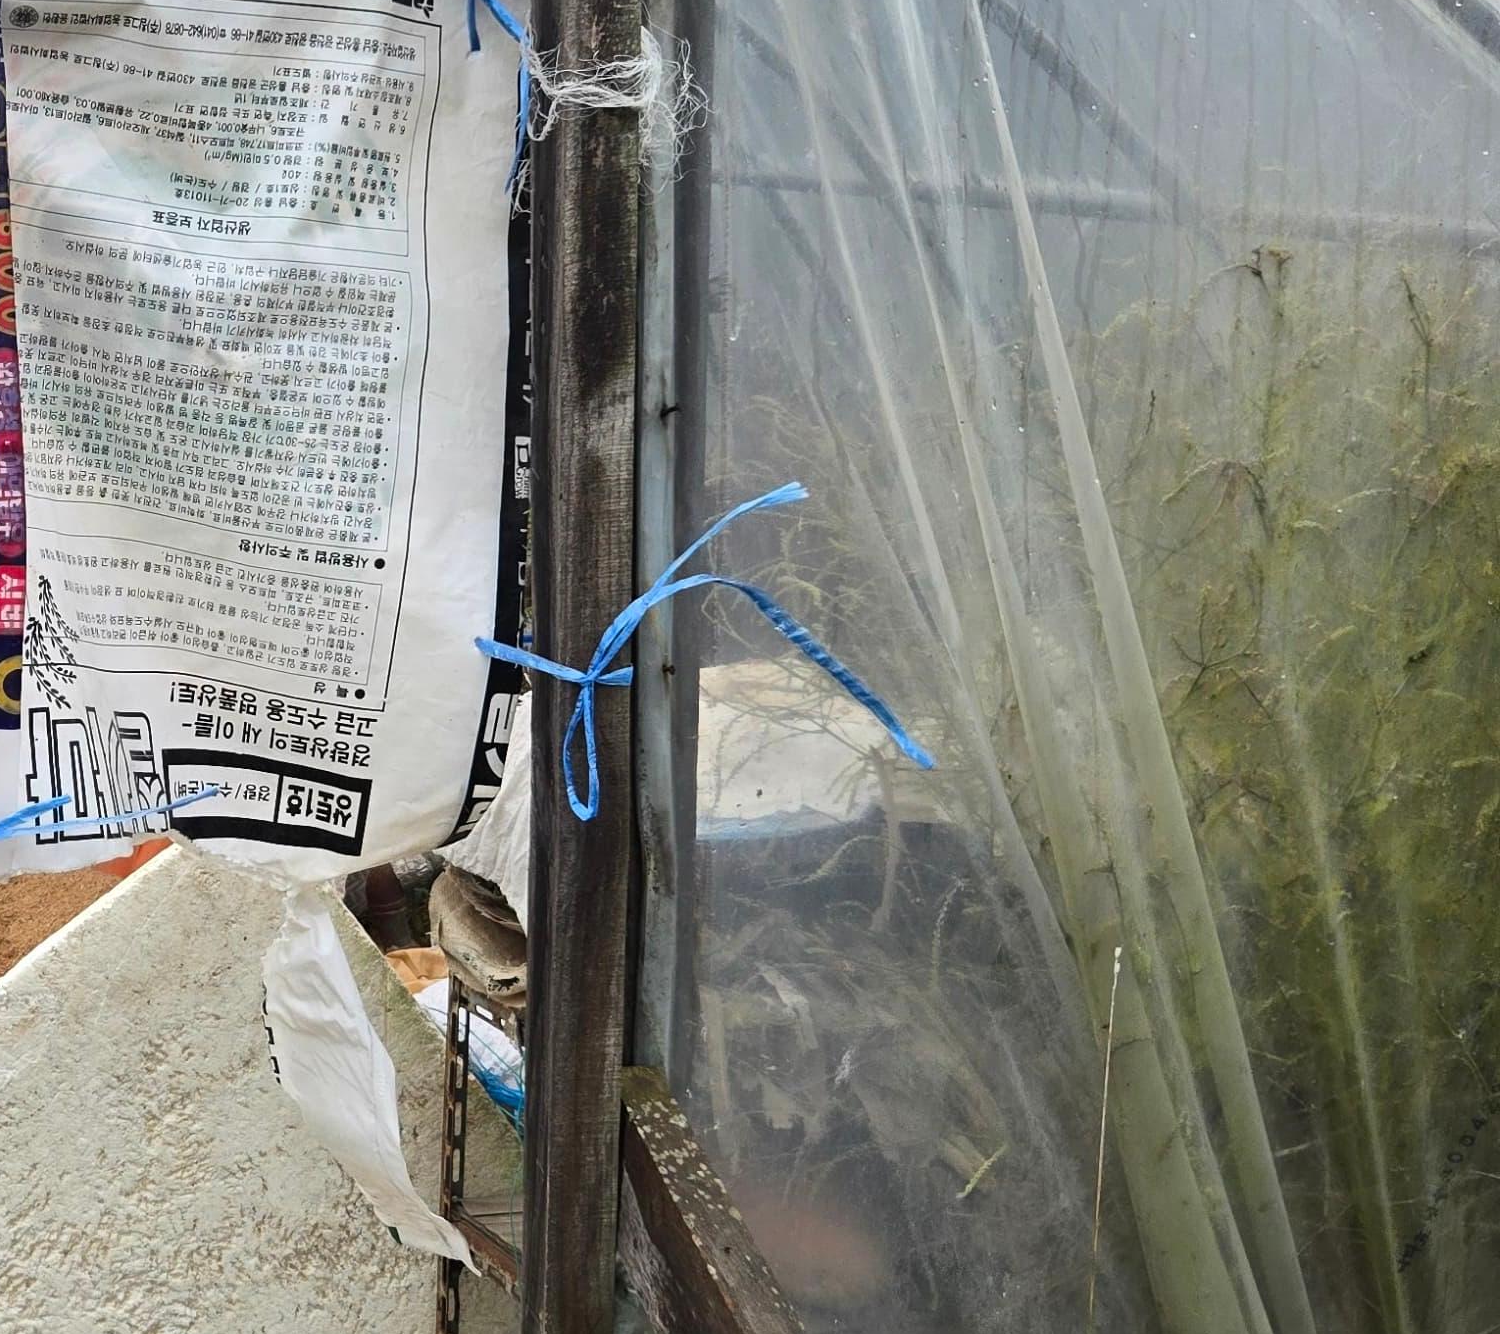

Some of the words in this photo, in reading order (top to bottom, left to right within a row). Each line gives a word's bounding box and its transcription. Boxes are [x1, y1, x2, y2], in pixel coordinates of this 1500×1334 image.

[152, 209, 192, 231] 보증표
[196, 216, 252, 236] 생산업자
[238, 539, 292, 558] 주의사항
[297, 548, 309, 561] 및
[314, 550, 369, 568] 사용방법
[313, 681, 326, 695] 성
[335, 685, 349, 699] 특
[169, 681, 257, 717] 명품상토!
[266, 698, 328, 728] 수도용
[241, 720, 262, 745] 새
[334, 712, 378, 739] 고급
[269, 728, 371, 768] 경량상토의
[244, 785, 271, 802] 경량
[285, 784, 353, 829] 상토1호
